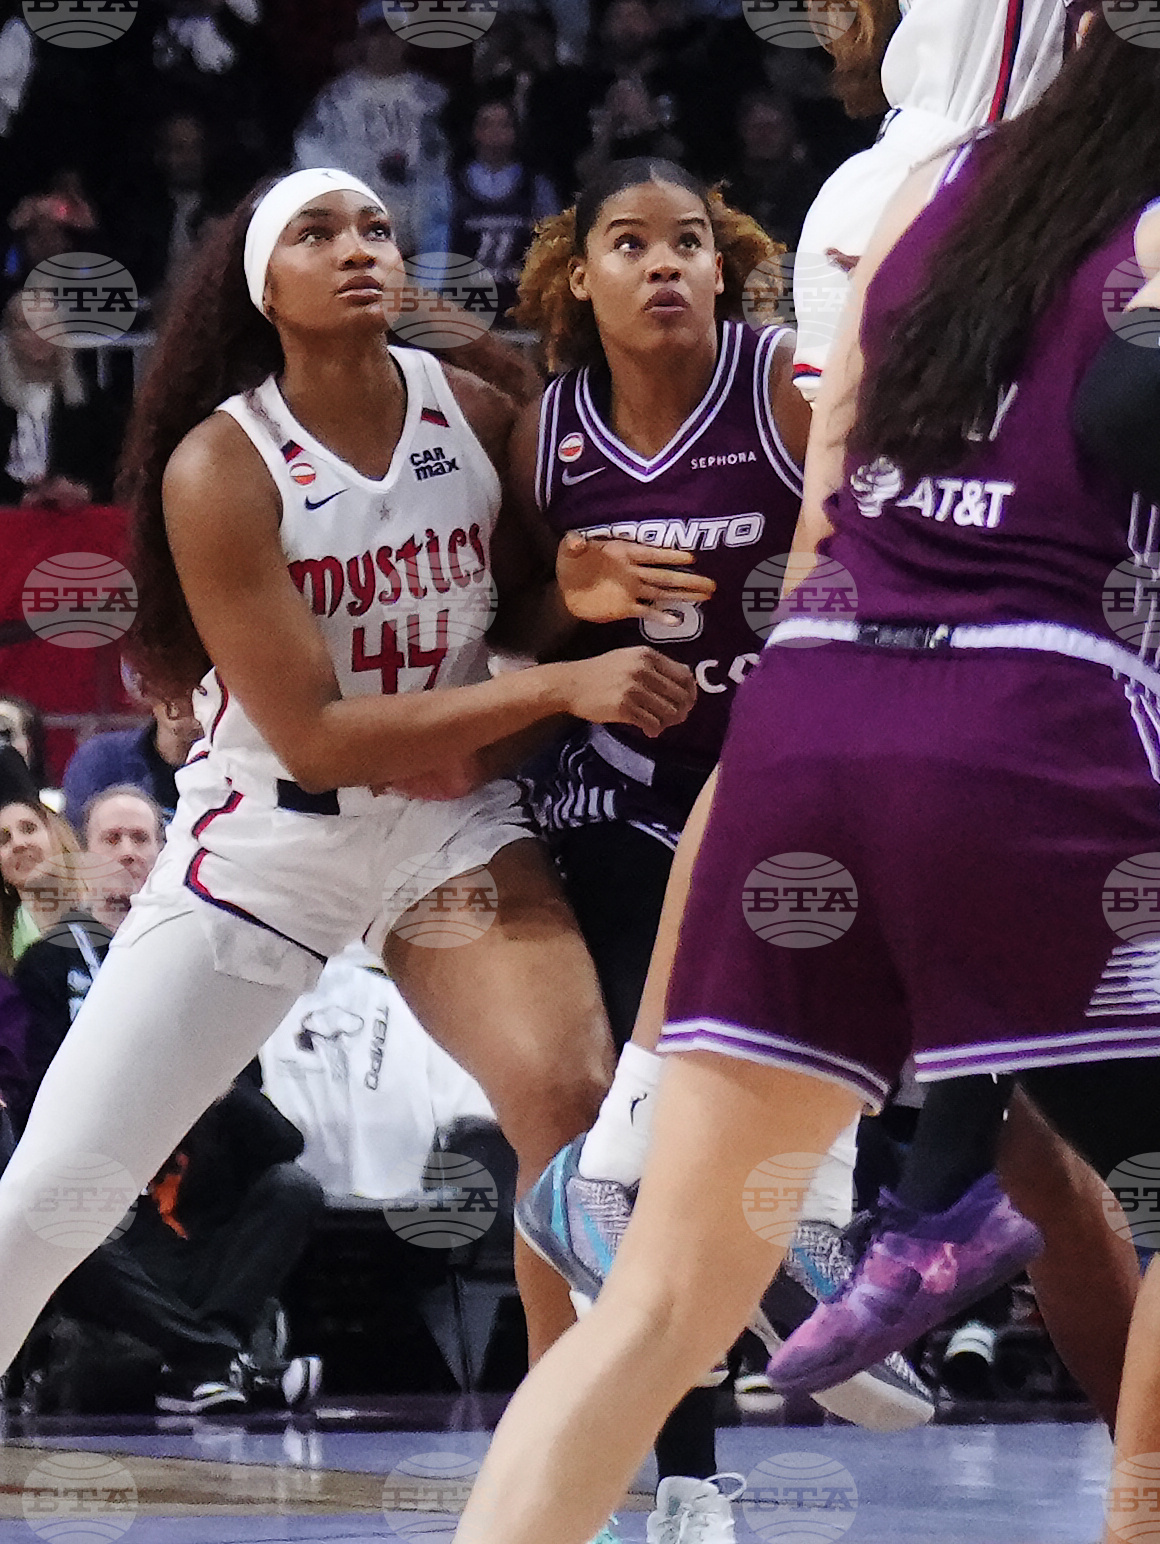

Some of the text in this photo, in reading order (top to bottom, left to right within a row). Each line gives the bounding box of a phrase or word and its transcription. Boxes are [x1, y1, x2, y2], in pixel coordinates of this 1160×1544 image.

[409, 446, 446, 466] CAR
[691, 451, 757, 470] SEPHORA
[415, 458, 460, 481] max
[895, 476, 1016, 528] AT&T
[351, 609, 450, 695] 44
